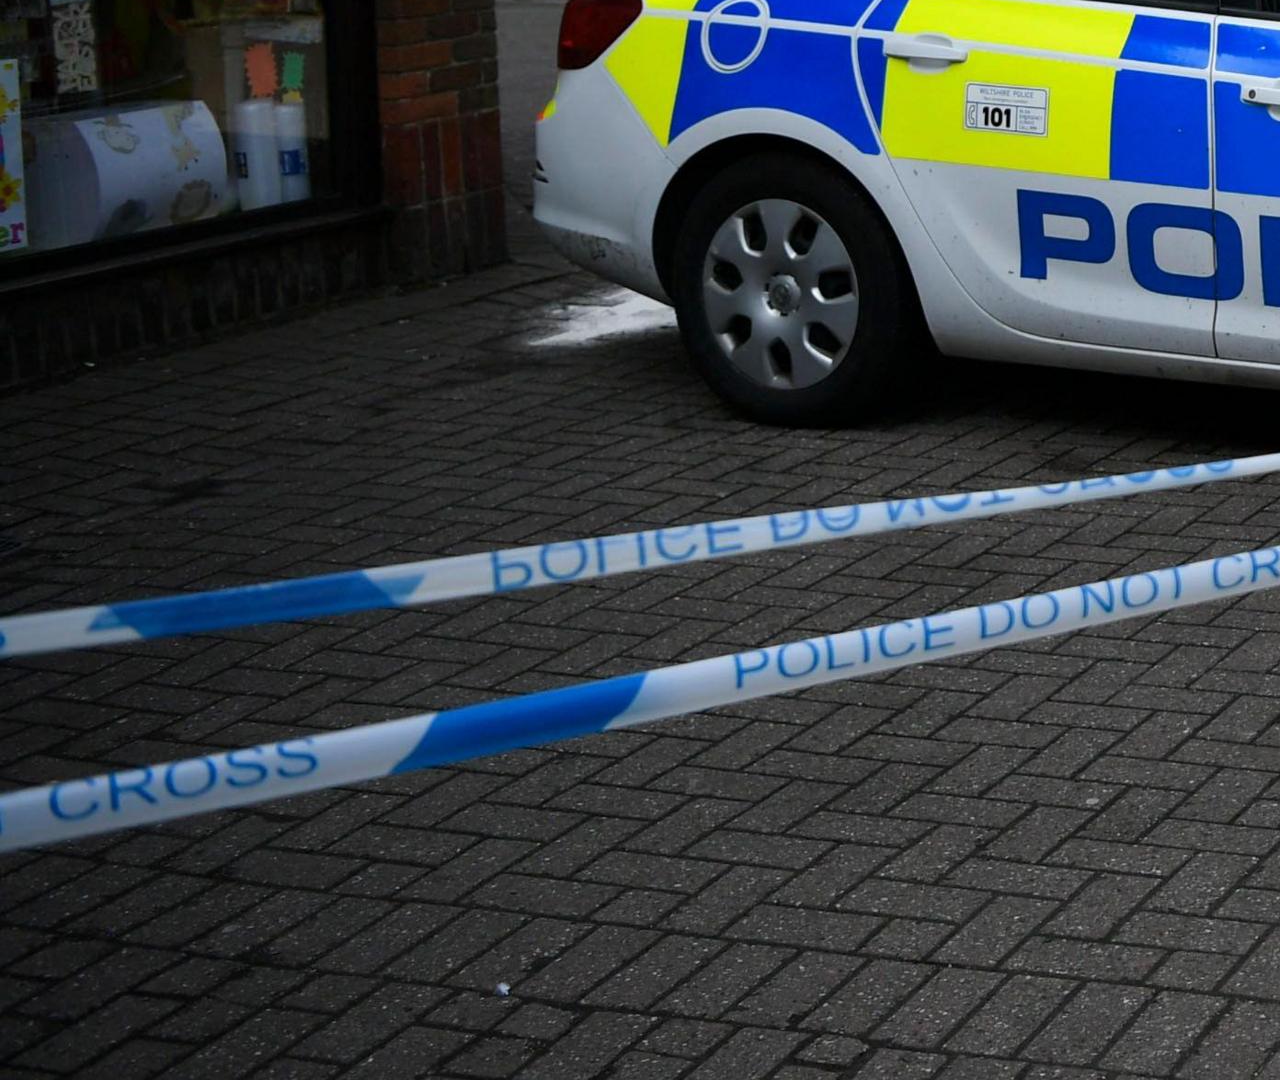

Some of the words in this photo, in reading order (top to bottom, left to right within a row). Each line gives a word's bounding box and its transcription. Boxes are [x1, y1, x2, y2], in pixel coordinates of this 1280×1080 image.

[982, 106, 1011, 128] 101
[1012, 90, 1034, 99] POLICE
[733, 621, 959, 689] POLICE
[977, 591, 1061, 641] DO
[1080, 566, 1187, 620] NOT
[48, 737, 319, 822] CROSS
